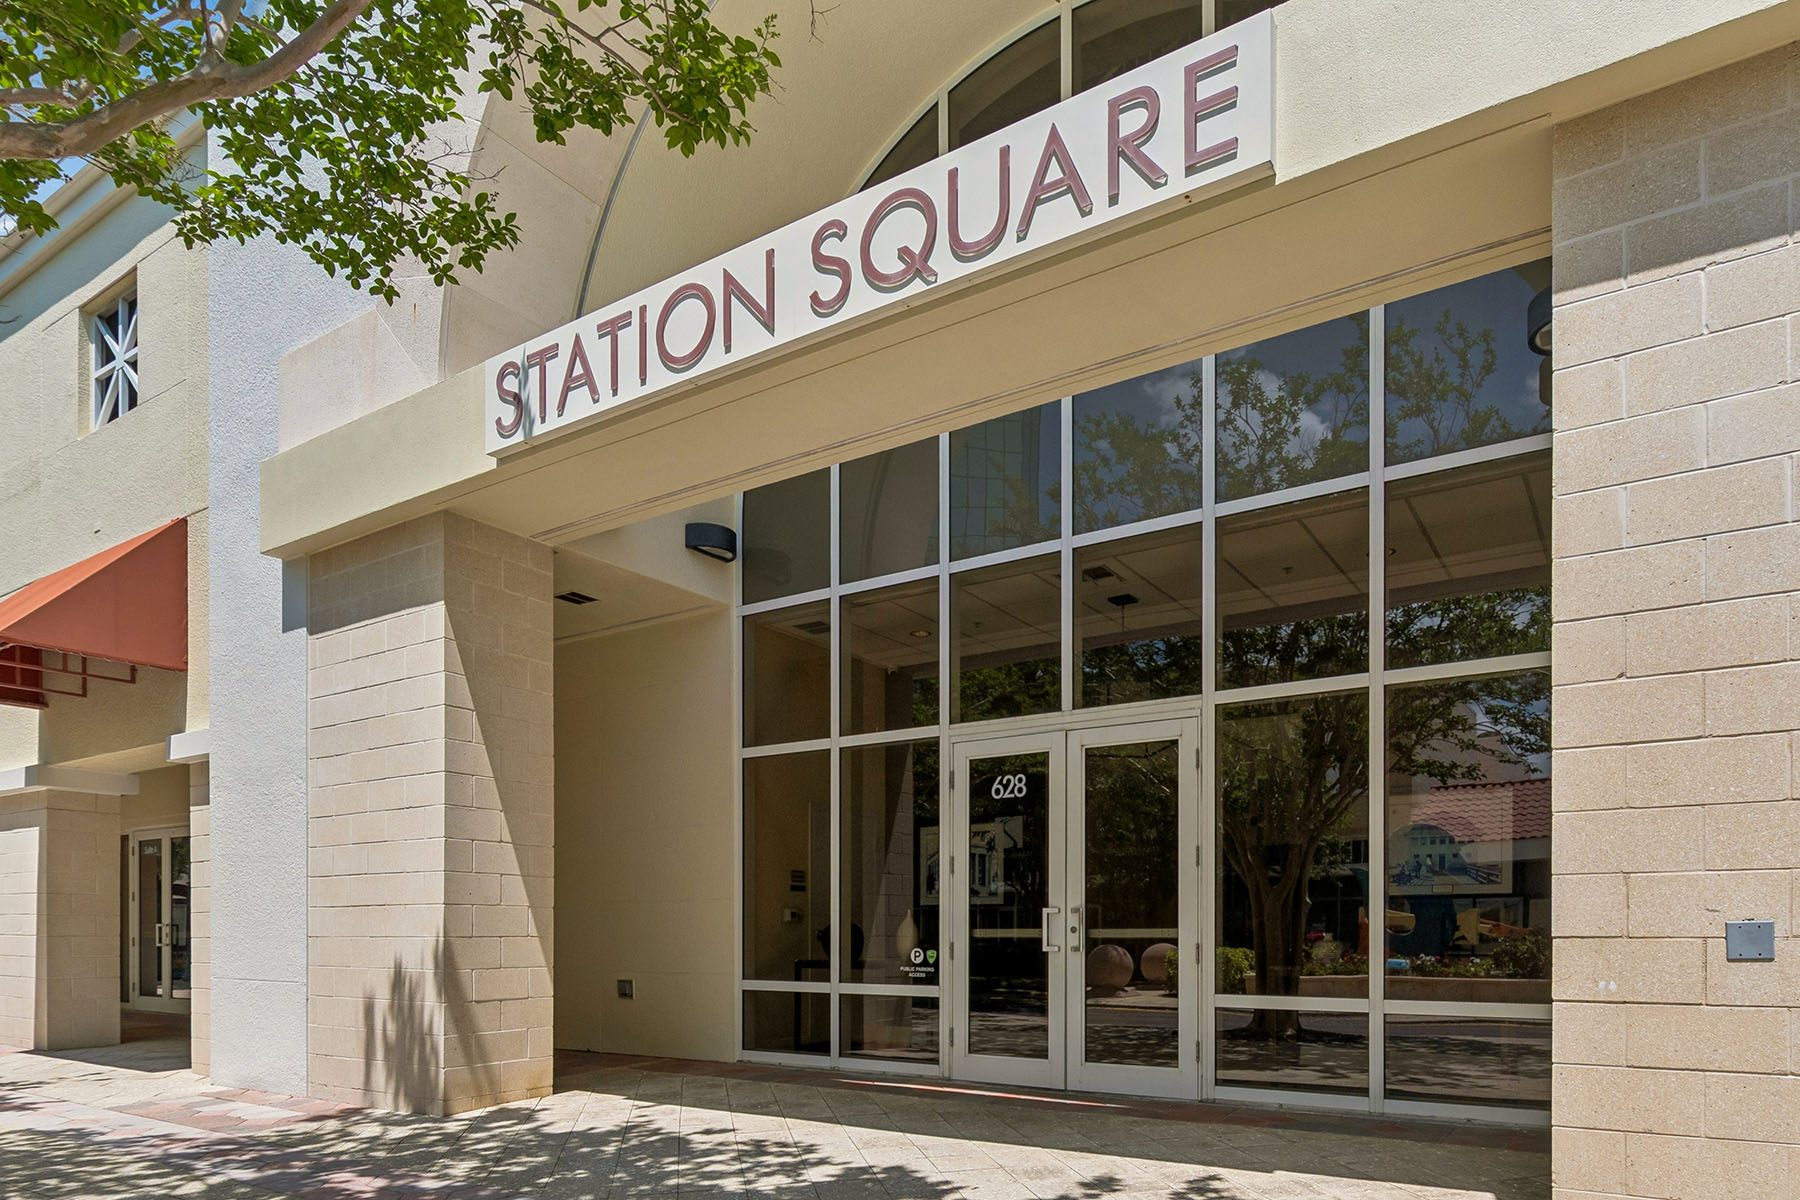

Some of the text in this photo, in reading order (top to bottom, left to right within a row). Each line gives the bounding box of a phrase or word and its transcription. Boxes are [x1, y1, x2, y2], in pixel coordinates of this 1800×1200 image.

[495, 44, 1238, 435] STATION SQUARE
[991, 773, 1027, 800] 628
